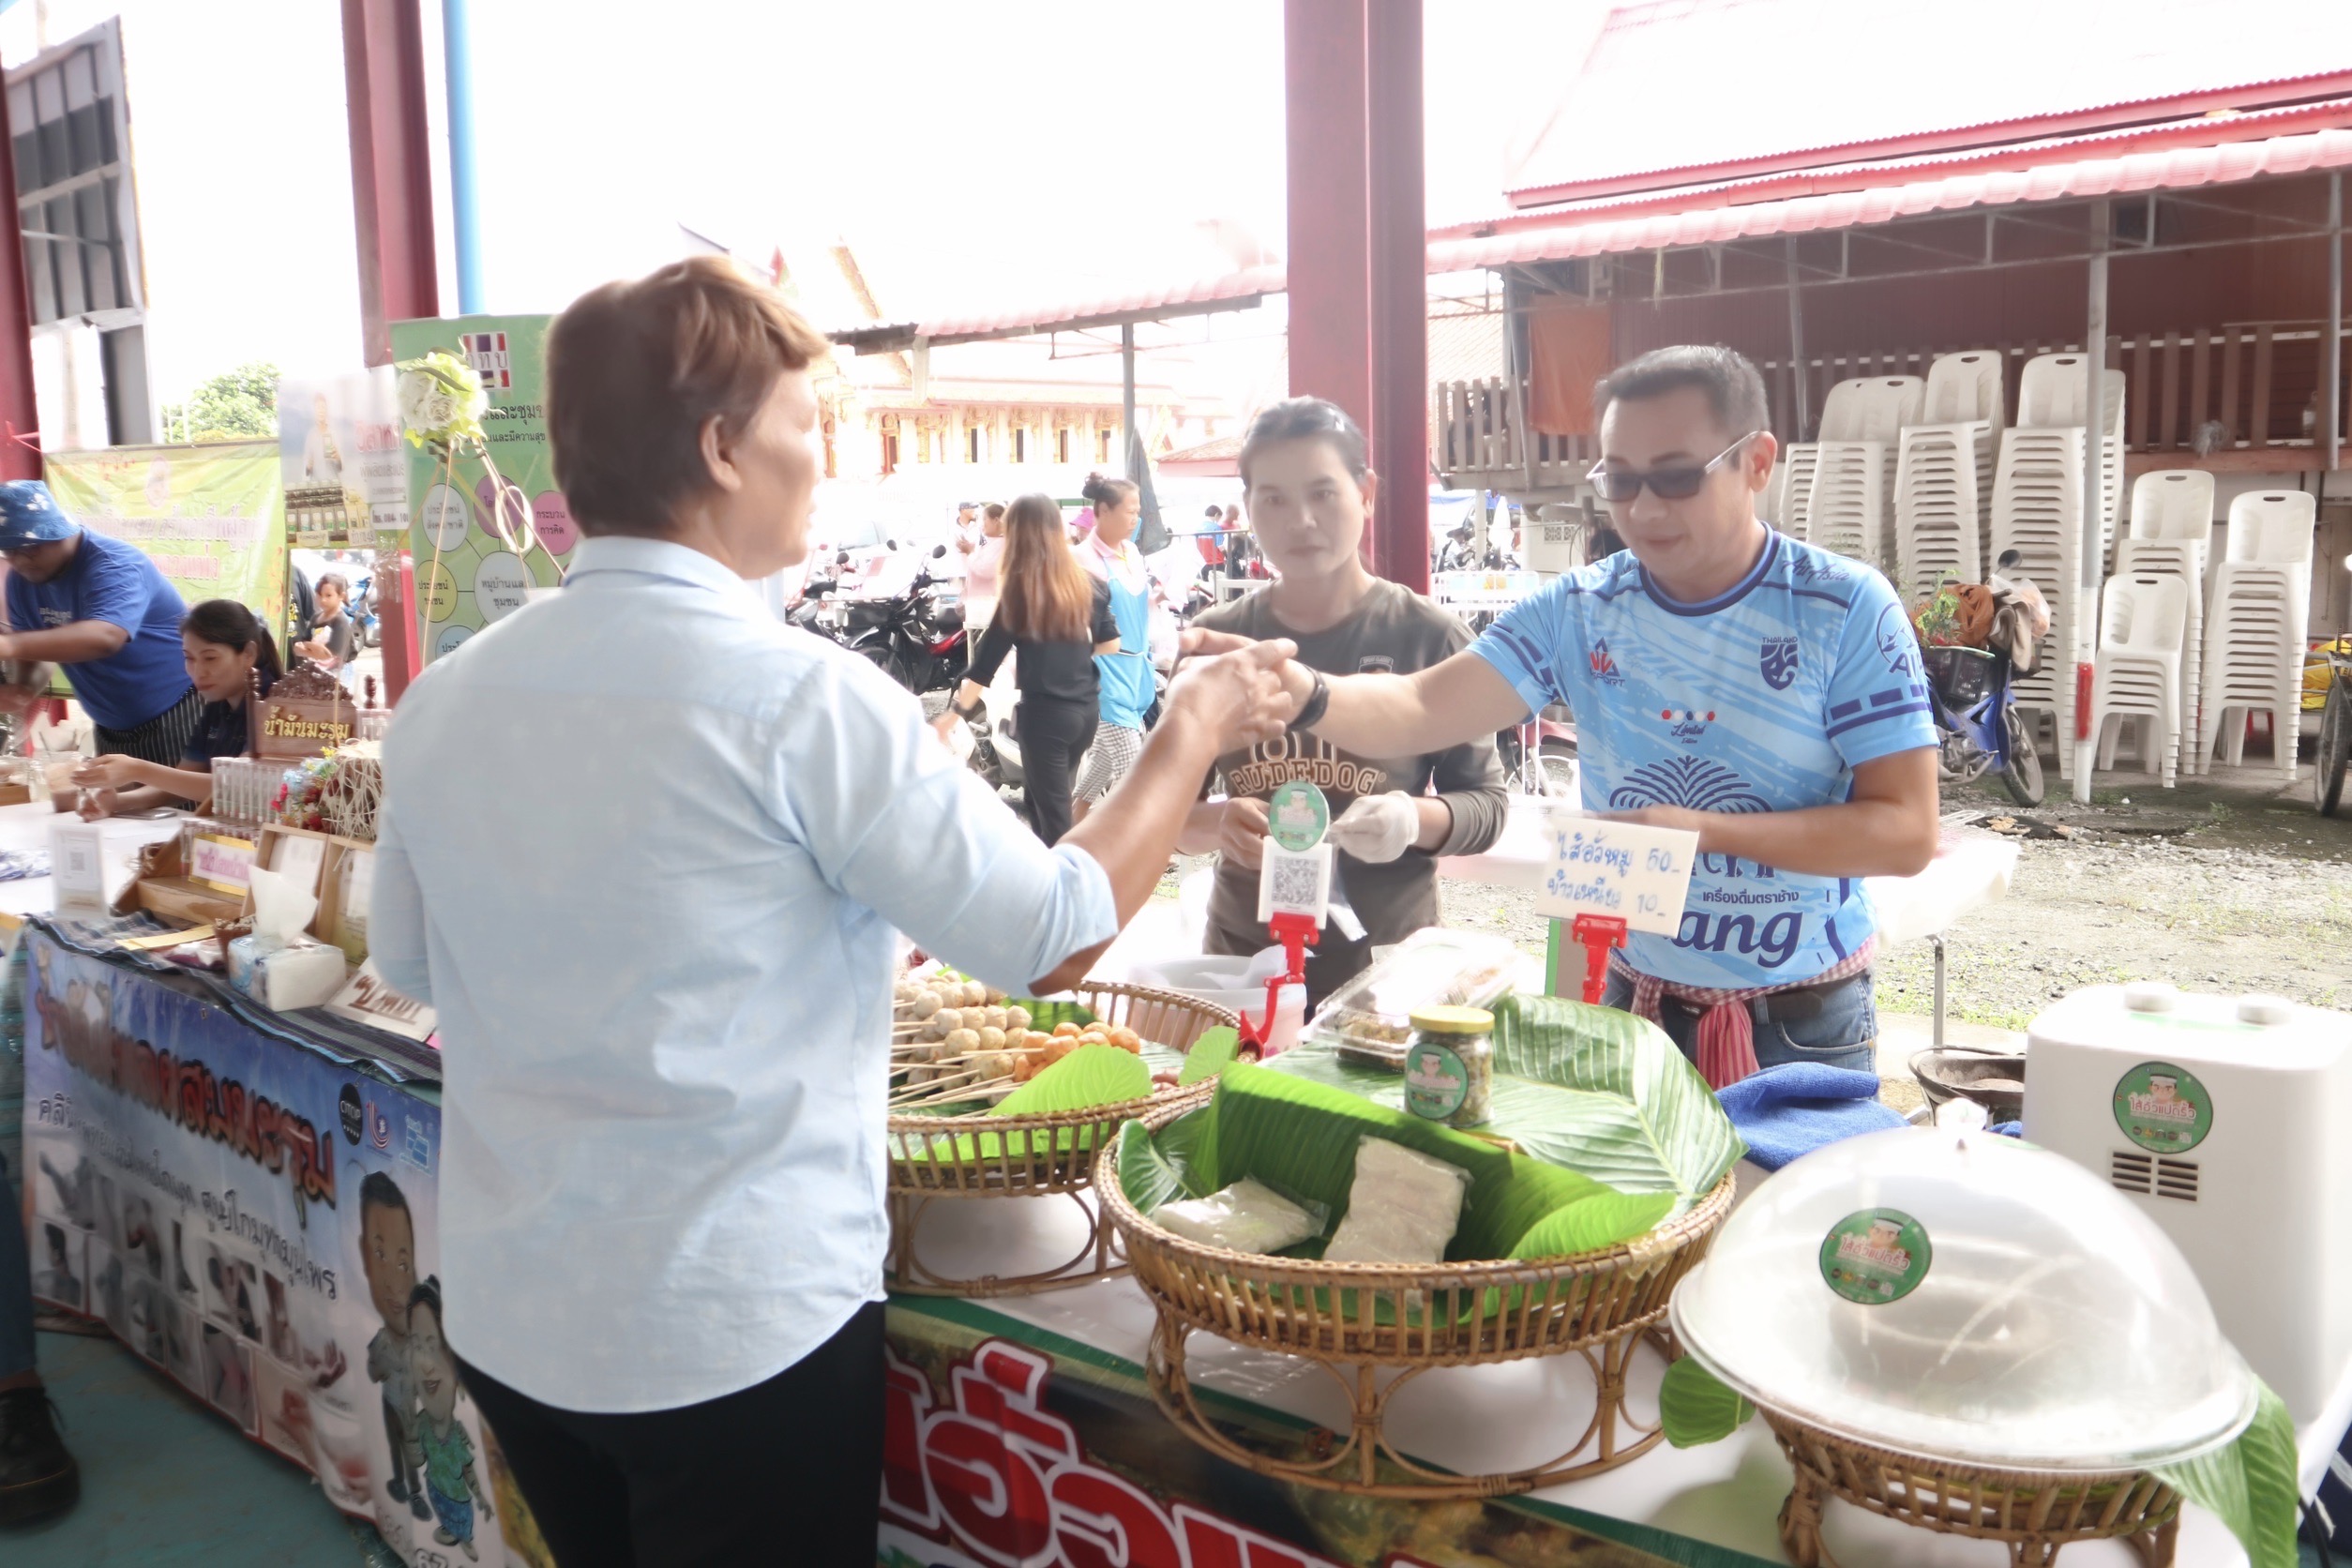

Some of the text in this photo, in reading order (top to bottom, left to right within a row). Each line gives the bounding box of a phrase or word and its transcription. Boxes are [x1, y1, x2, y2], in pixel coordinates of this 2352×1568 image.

[493, 596, 519, 610] ชุมชน
[1762, 636, 1799, 644] THAILAND
[264, 705, 350, 747] น้ำมันมะรุม
[1703, 887, 1800, 904] เครื่องดื่มตราช้าง
[339, 1100, 361, 1121] OTOP
